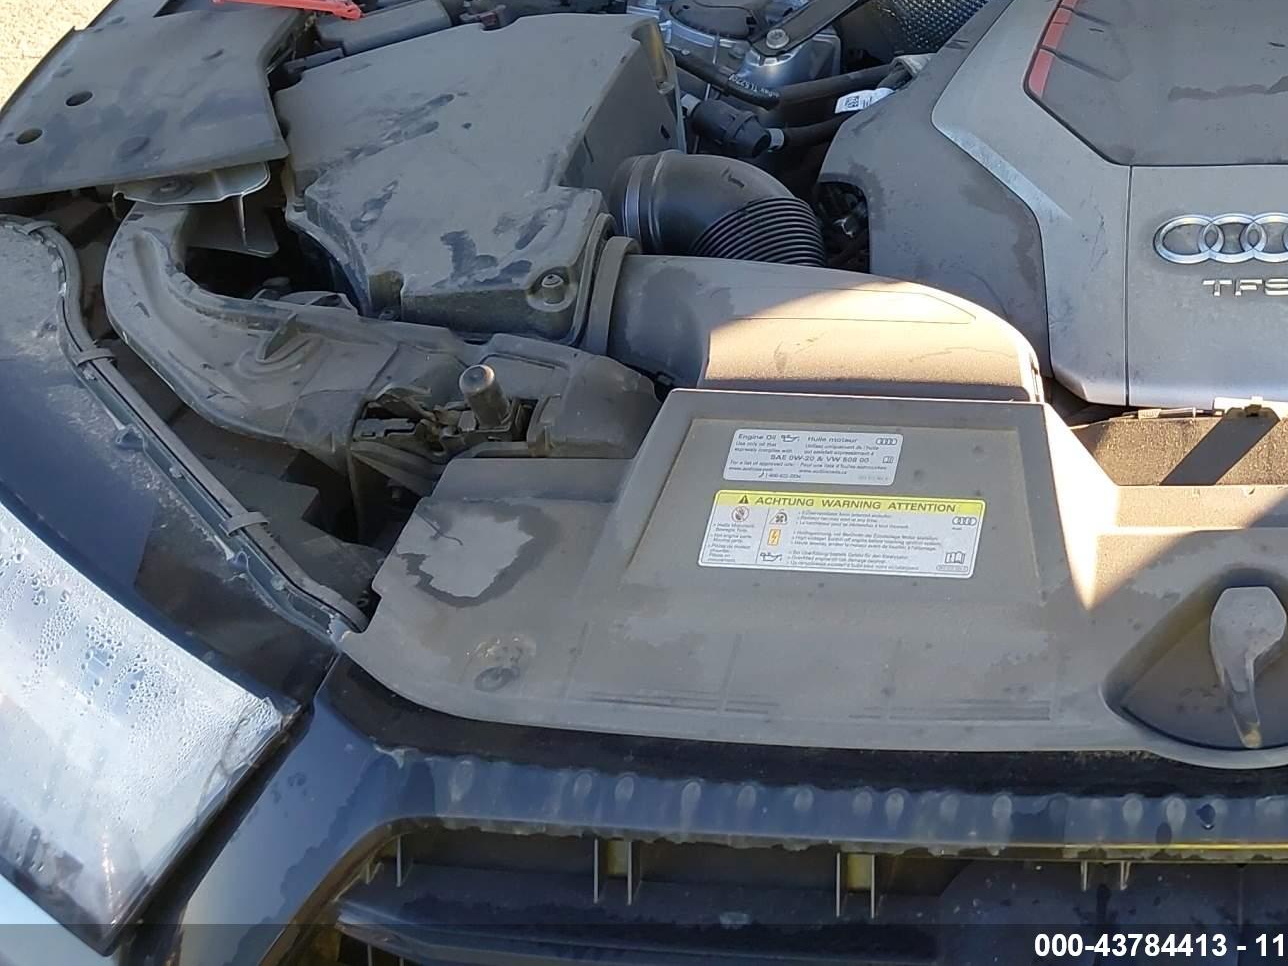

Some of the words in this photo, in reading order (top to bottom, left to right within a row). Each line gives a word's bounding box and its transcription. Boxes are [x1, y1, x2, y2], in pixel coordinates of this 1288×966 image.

[738, 433, 764, 441] Engine
[755, 496, 815, 507] ACHTUNG
[821, 499, 881, 510] WARNING
[887, 501, 956, 513] ATTENTION
